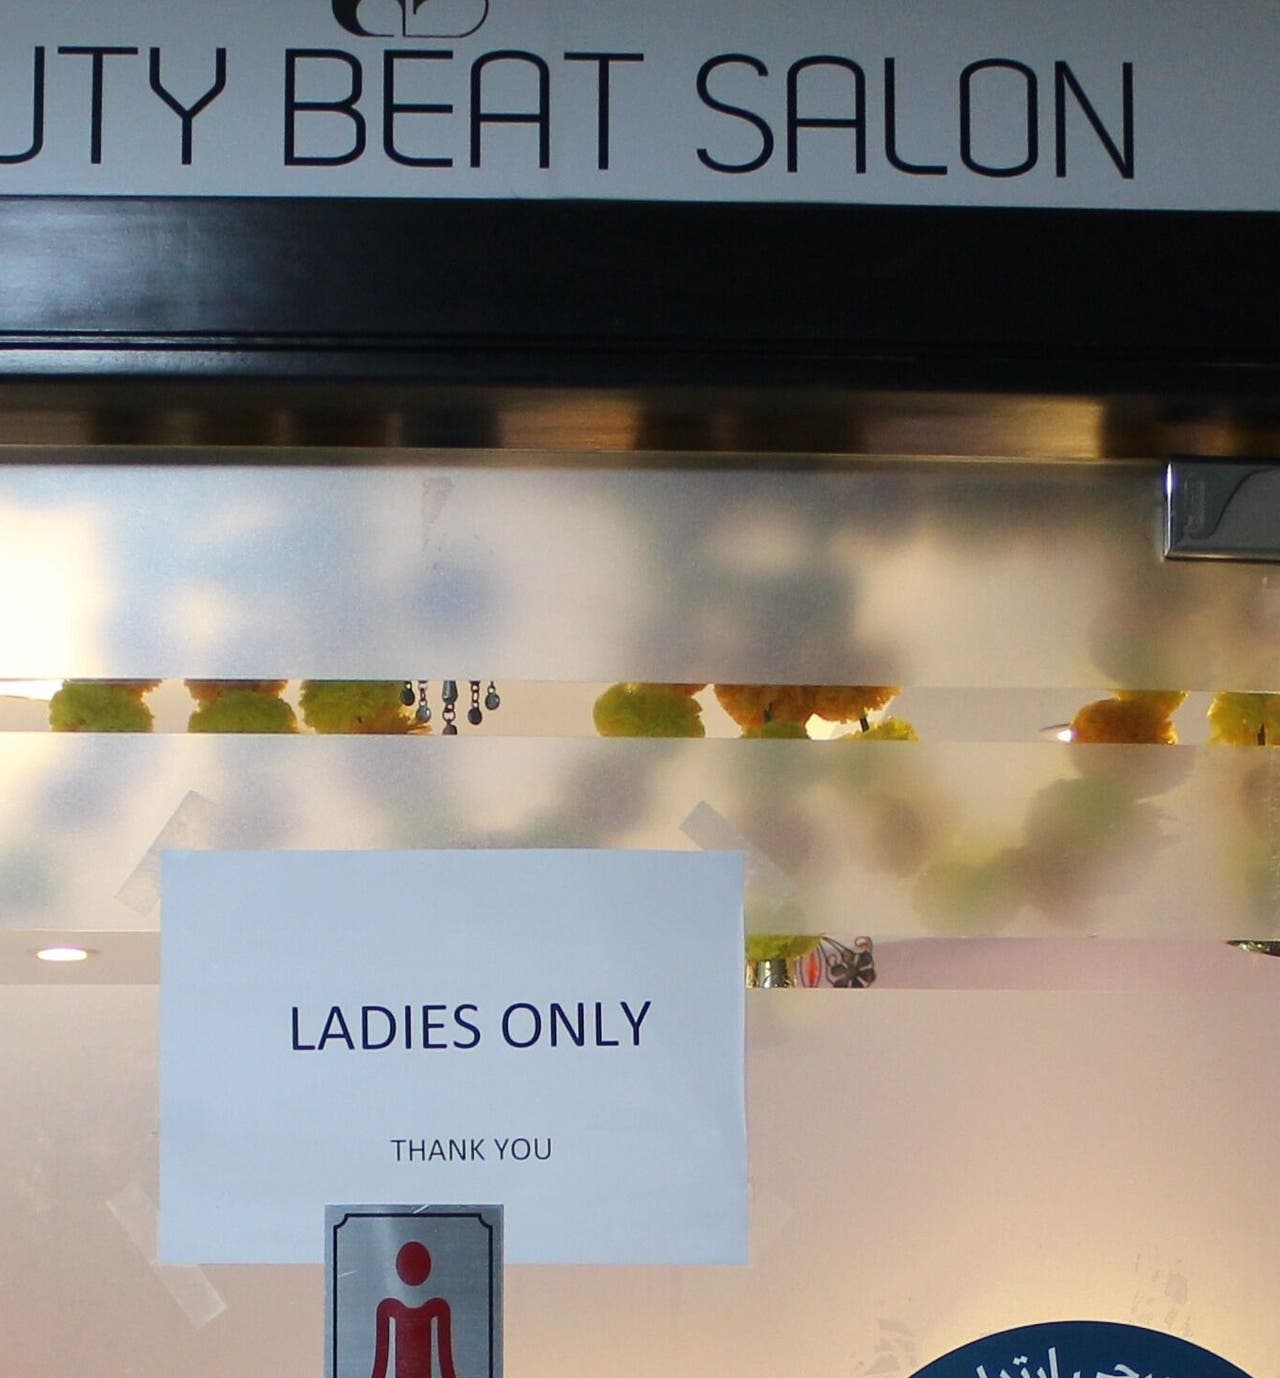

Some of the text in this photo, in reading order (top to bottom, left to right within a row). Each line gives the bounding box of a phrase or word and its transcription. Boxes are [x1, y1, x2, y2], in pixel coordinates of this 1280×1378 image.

[285, 49, 644, 169] BEAT
[697, 54, 1134, 179] SALON
[291, 1000, 652, 1051] LADIES ONLY
[390, 1137, 553, 1162] THANK YOU
